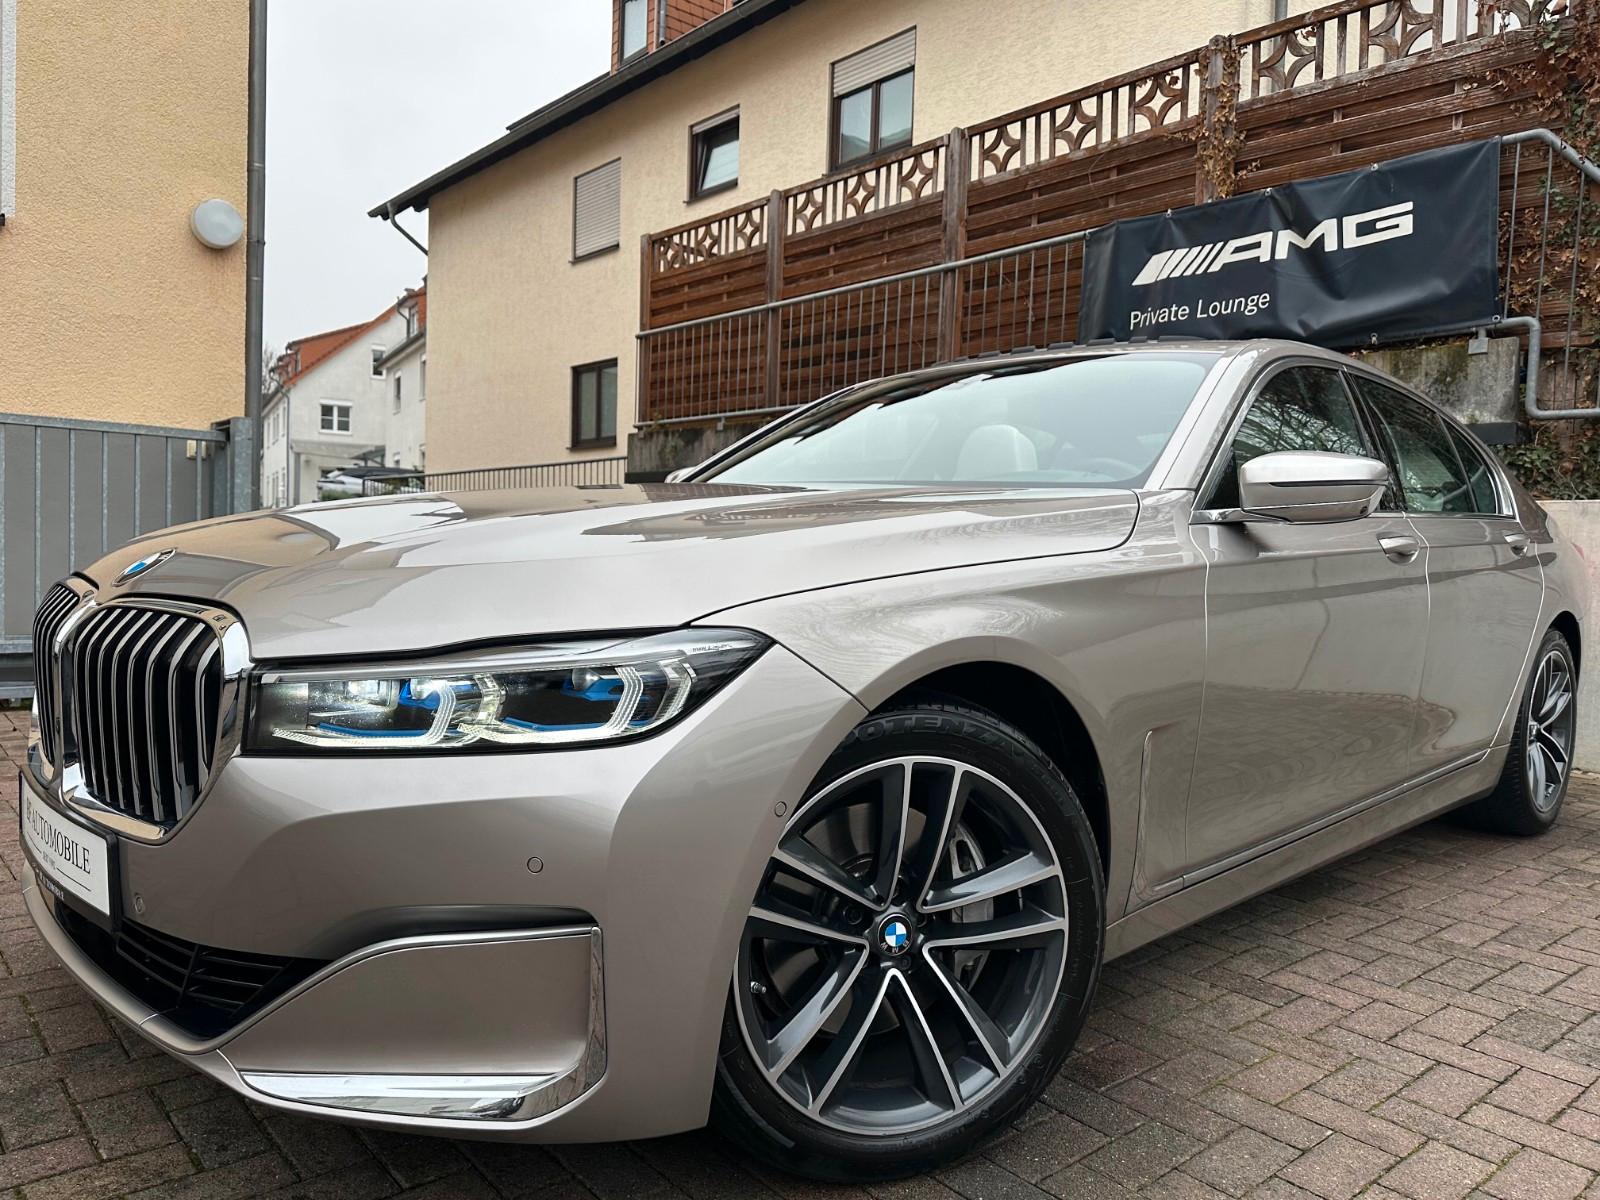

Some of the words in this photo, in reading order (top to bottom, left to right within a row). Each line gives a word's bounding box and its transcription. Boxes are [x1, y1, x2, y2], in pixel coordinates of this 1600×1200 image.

[1207, 201, 1414, 274] AMG
[1130, 303, 1189, 331] Private
[1197, 292, 1270, 319] Lounge
[31, 809, 91, 875] AUTOMOBILE
